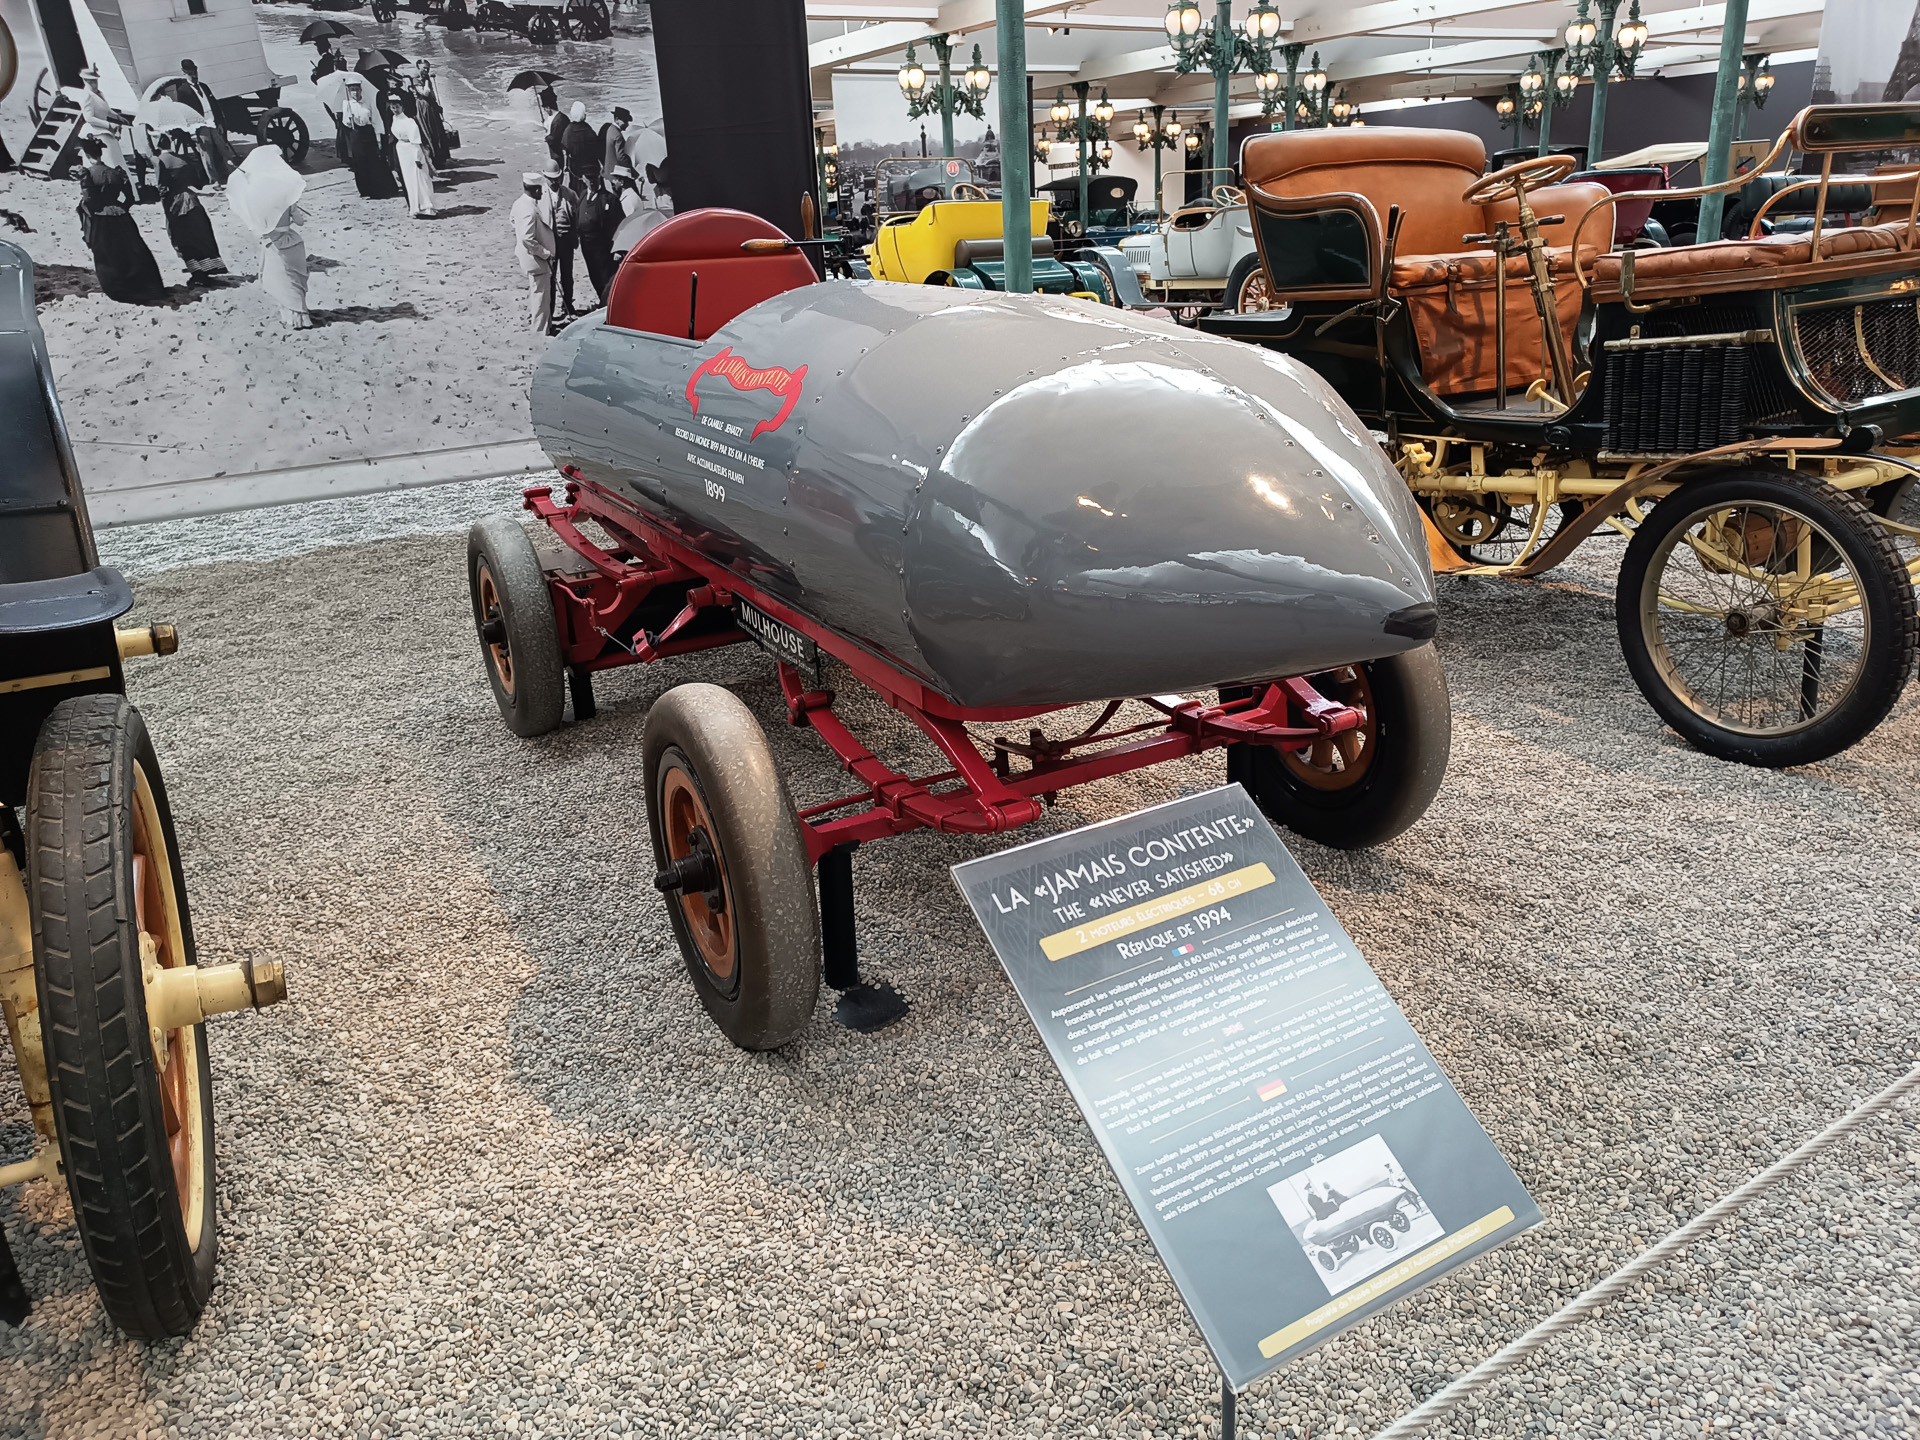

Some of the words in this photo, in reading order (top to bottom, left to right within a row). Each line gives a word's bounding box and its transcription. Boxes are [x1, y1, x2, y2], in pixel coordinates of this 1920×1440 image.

[713, 358, 727, 373] LA
[744, 370, 792, 393] CONTENTE
[701, 416, 707, 425] DE
[707, 418, 724, 431] CAMILLE
[675, 428, 689, 440] RECORD
[689, 432, 695, 442] DU
[695, 434, 710, 448] MONDE
[710, 439, 720, 452] 1899
[719, 442, 728, 455] PAR
[735, 448, 743, 461] KM
[747, 454, 766, 470] L'HEURE
[687, 453, 697, 465] AVEC
[696, 456, 728, 477] ACCUMULATEURS
[728, 470, 745, 485] FULMEN
[704, 479, 726, 503] 1899
[741, 602, 805, 659] MULHOUSE
[991, 886, 1030, 913] LA
[1033, 853, 1126, 904] «JAMAIS
[1127, 814, 1254, 867] CONTENTE»
[1052, 901, 1086, 923] THE
[1089, 879, 1154, 908] «NEVER
[1155, 851, 1234, 888] SATISFIED»
[1075, 930, 1088, 943] 2
[1089, 915, 1135, 938] MOTEURS
[1135, 894, 1195, 922] ÉLECTRIQUES
[1207, 881, 1225, 896] 68
[1227, 878, 1242, 889] CH
[1116, 929, 1177, 959] RÉPLIQUE
[1176, 923, 1195, 938] DE
[1192, 906, 1231, 931] 1994
